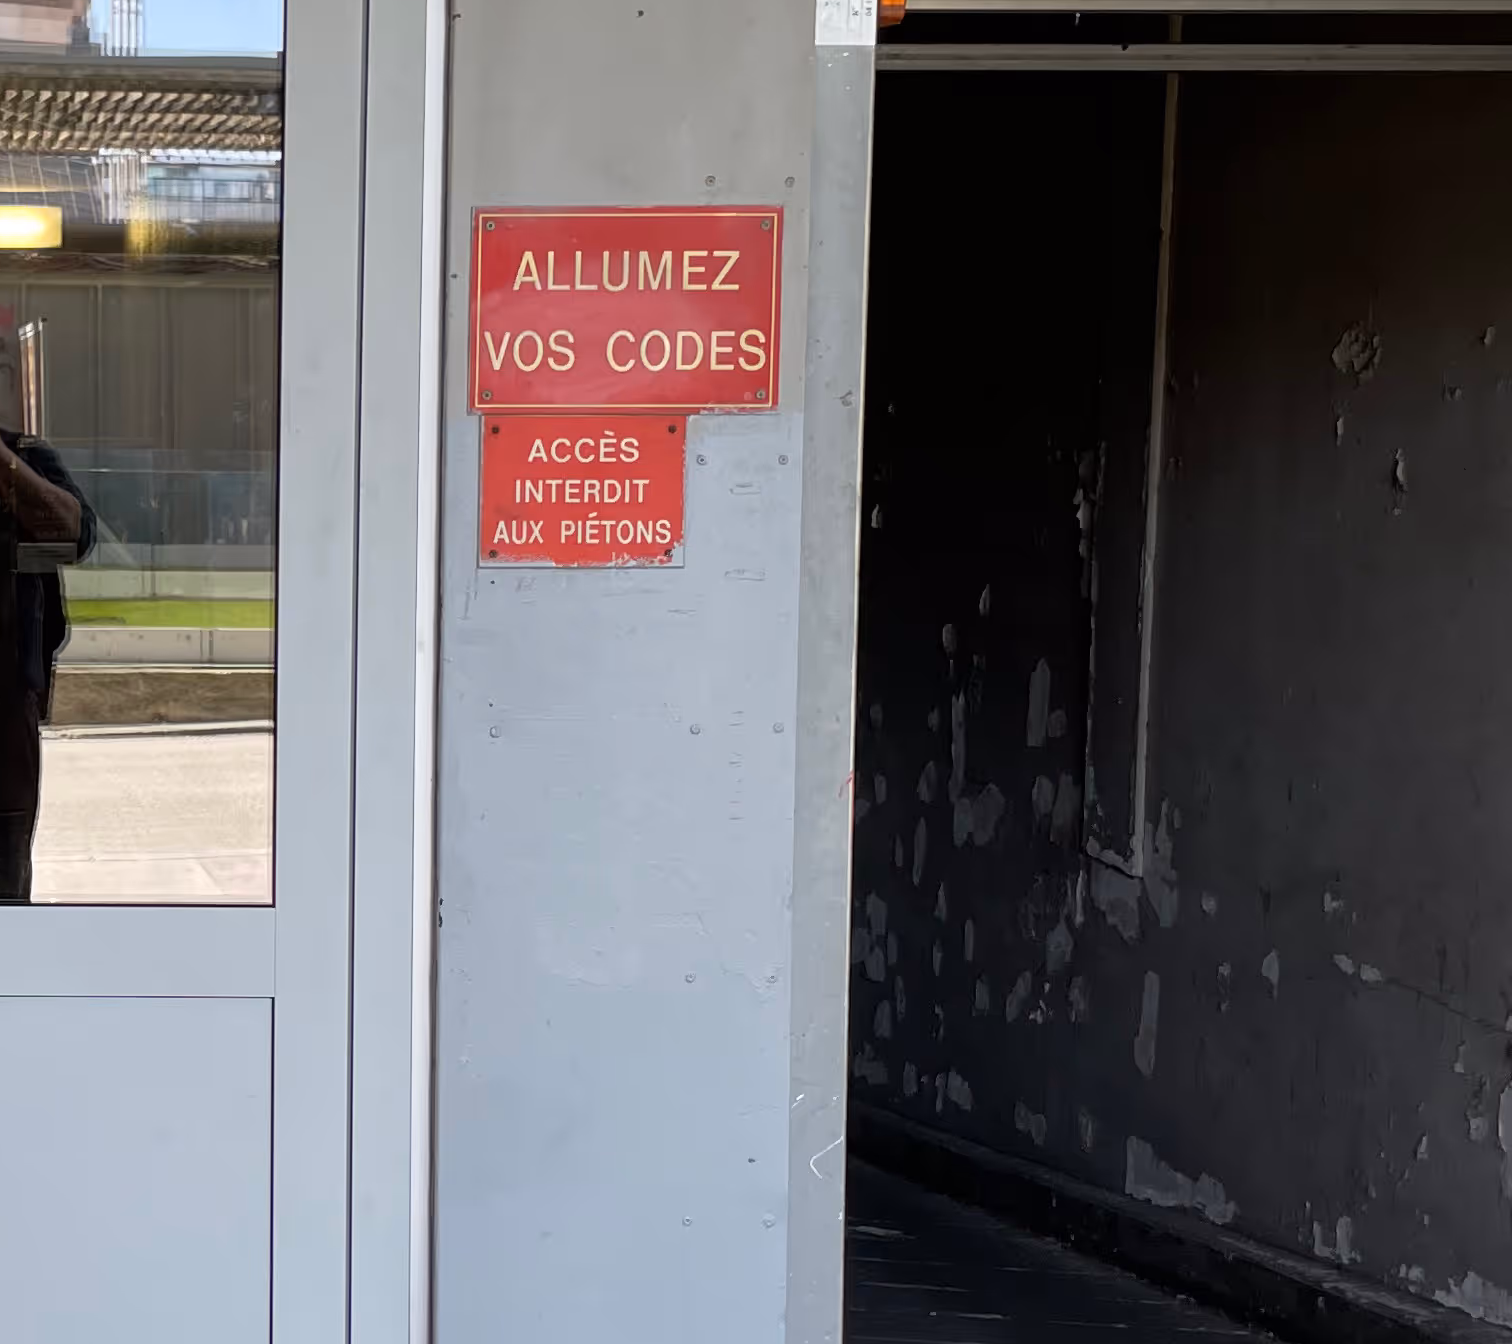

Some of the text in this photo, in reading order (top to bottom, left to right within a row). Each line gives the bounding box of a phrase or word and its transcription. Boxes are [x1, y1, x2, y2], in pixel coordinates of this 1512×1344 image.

[513, 250, 740, 291] ALLUMEZ
[483, 329, 767, 372] VOS CODES
[527, 430, 640, 463] ACCÈS
[514, 479, 650, 504] INTERDIT
[493, 512, 672, 545] AUX PIÉTONS
